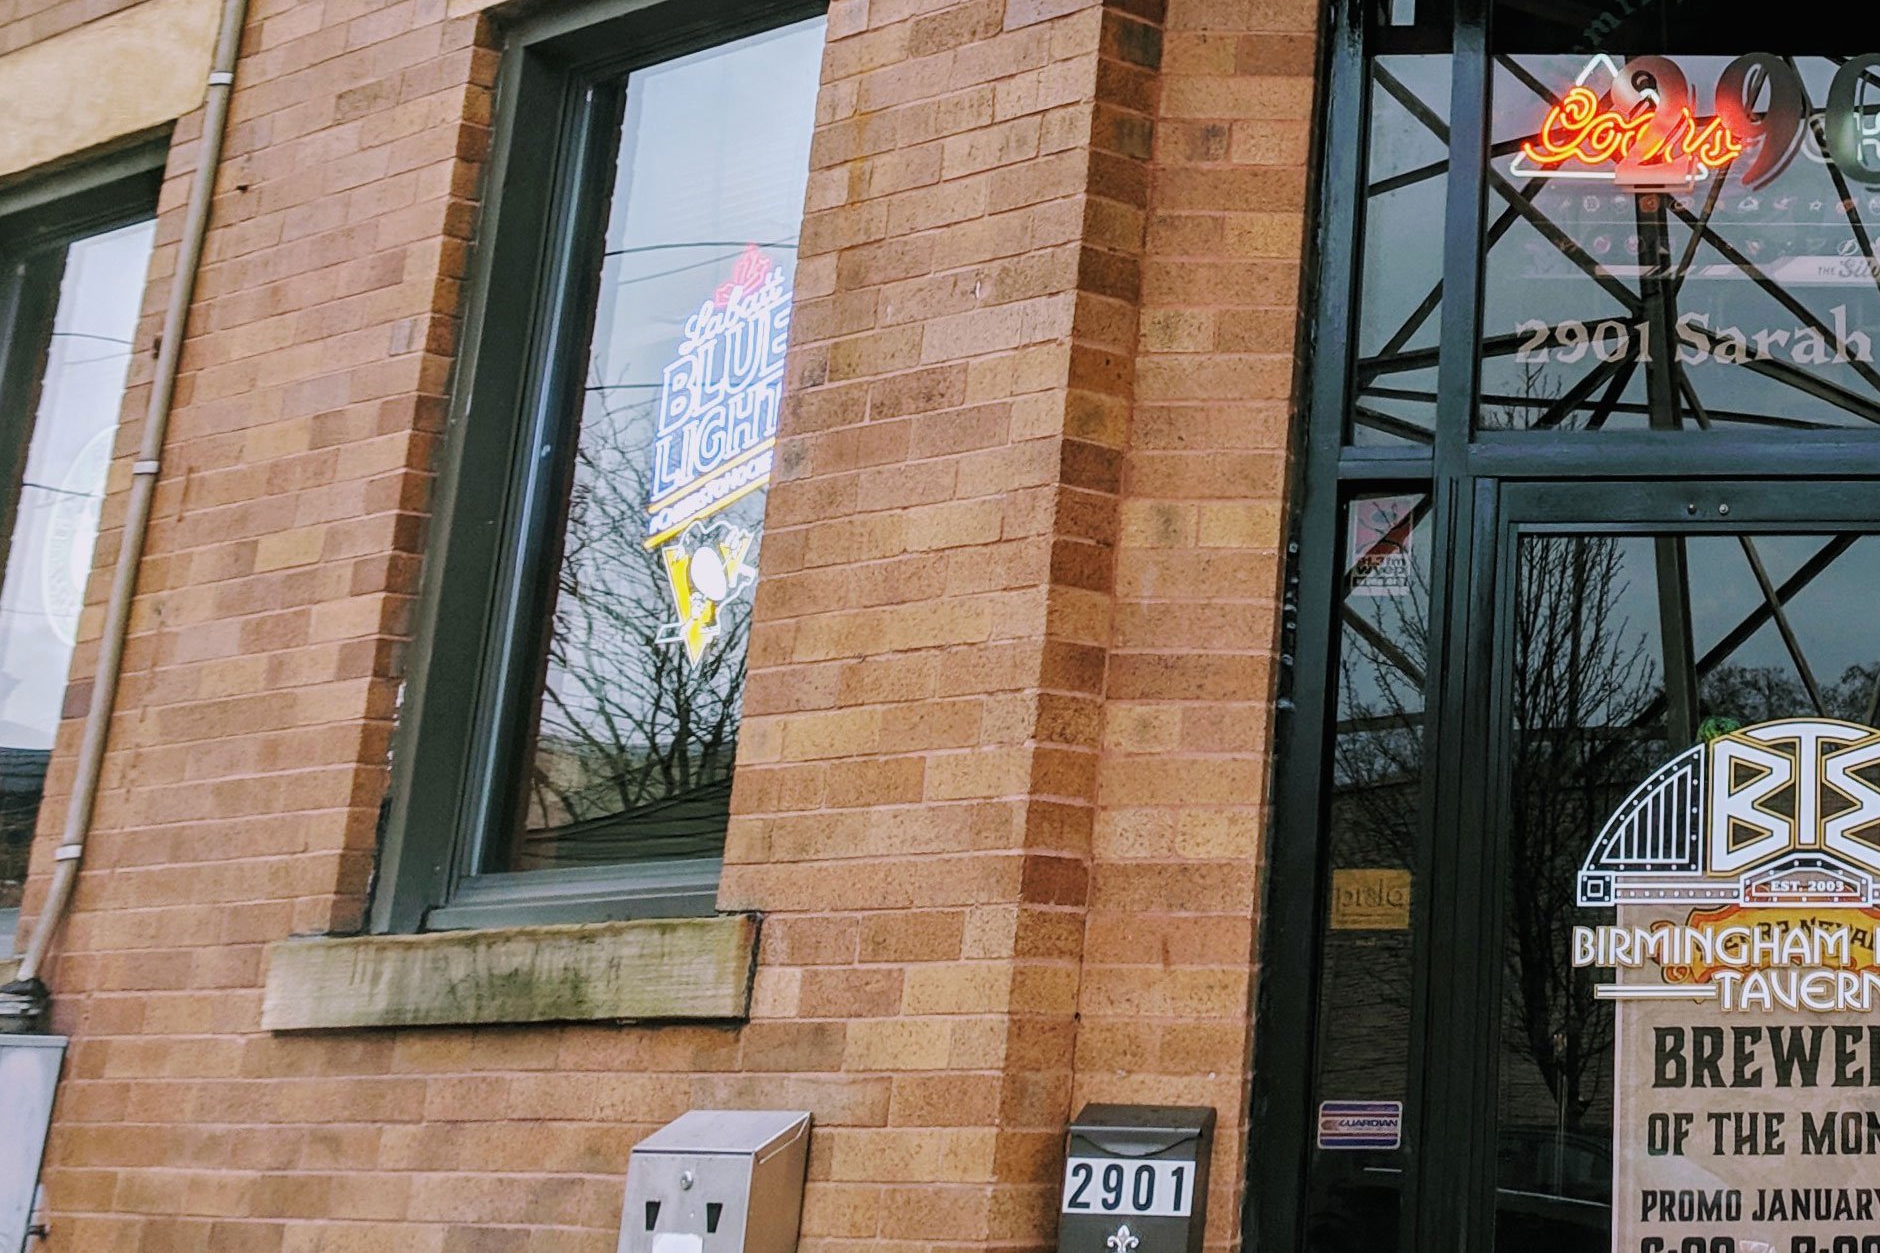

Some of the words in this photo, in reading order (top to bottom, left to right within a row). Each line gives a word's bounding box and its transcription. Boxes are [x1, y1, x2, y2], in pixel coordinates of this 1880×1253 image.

[1818, 266, 1836, 277] THE
[678, 265, 785, 356] Labatt
[1513, 320, 1653, 365] 2901
[1674, 304, 1874, 366] Sarah
[657, 305, 792, 438] BLUE
[650, 381, 784, 502] LIGHT
[1770, 880, 1804, 893] EST.
[1807, 880, 1845, 893] 2003
[1572, 925, 1850, 969] BIRMINGHAM
[1338, 1119, 1398, 1127] GUARDIAN
[1646, 1111, 1695, 1157] OF
[1707, 1111, 1786, 1157] THE
[1067, 1162, 1186, 1212] 2901
[1640, 1189, 1742, 1223] PROMO
